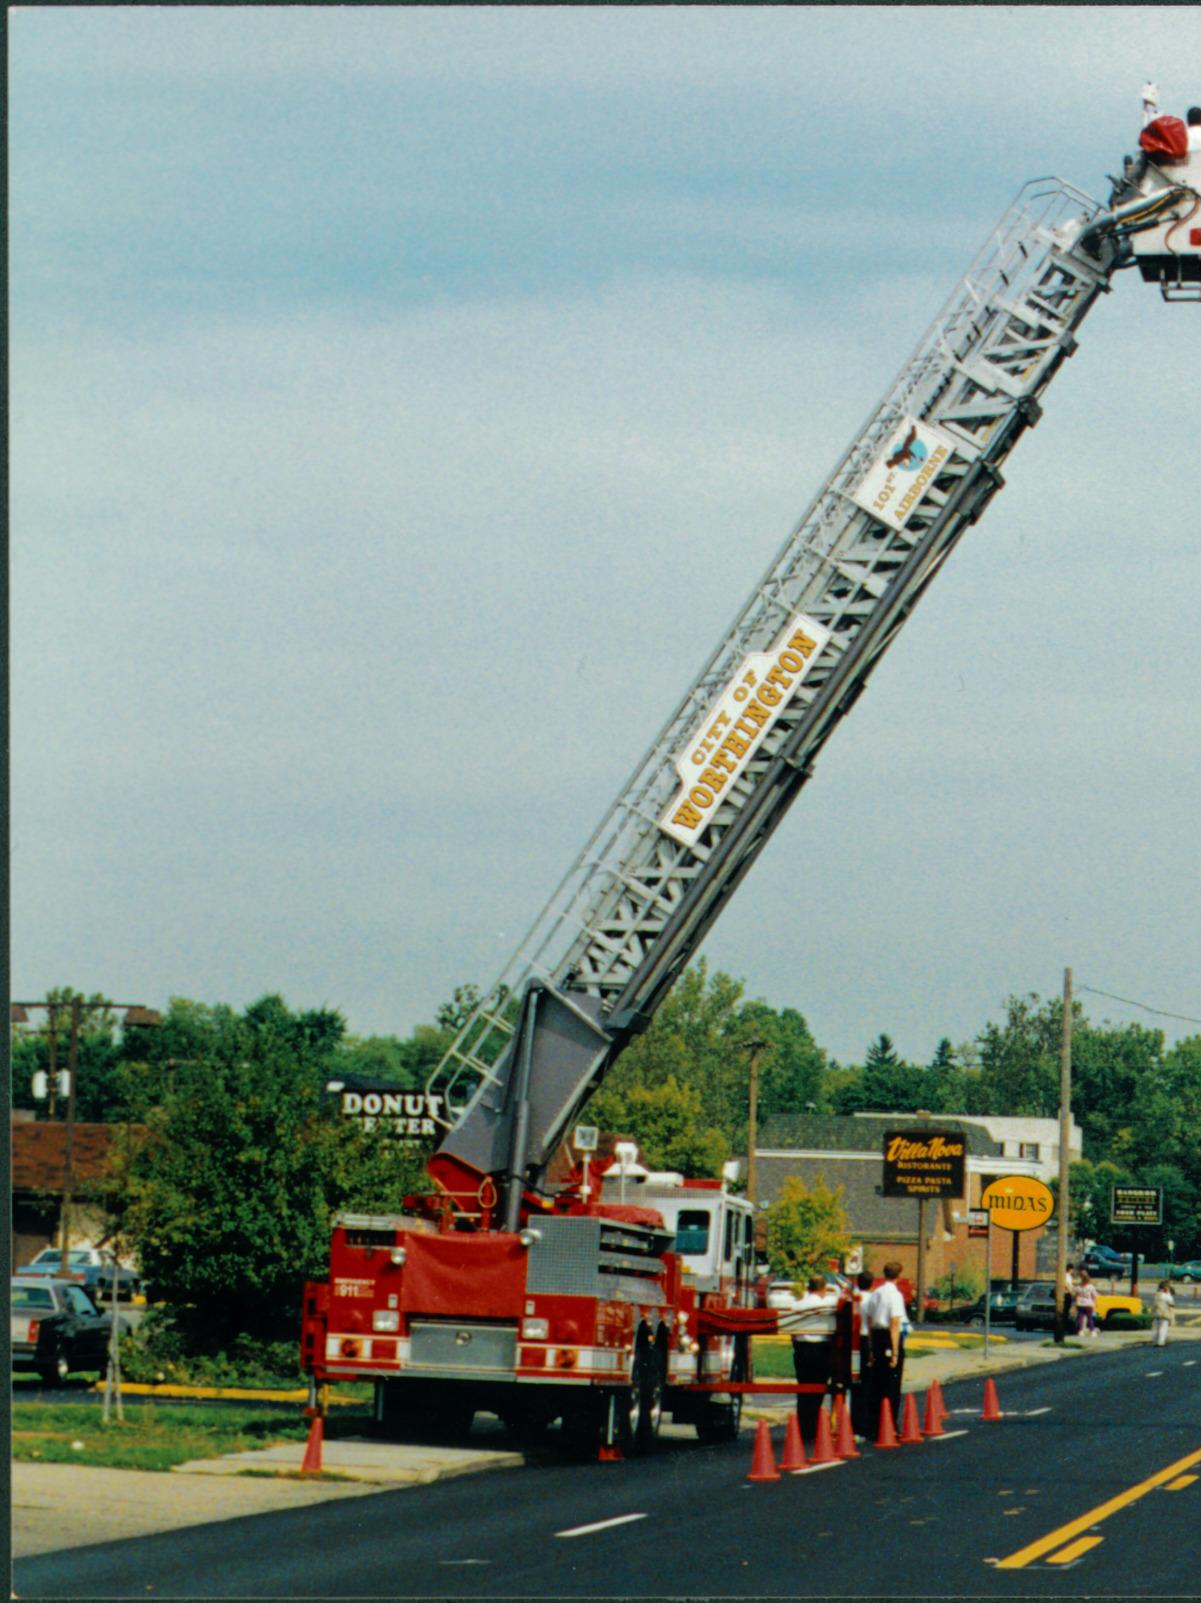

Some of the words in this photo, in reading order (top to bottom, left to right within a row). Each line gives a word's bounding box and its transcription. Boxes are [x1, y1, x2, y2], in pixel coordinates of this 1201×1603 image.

[894, 446, 949, 520] AIRBORNE
[671, 627, 818, 831] WORTHINGTON
[690, 709, 732, 766] CITY
[732, 668, 758, 703] OF
[341, 1092, 444, 1117] DONUT
[355, 1116, 436, 1136] ETER
[886, 1136, 928, 1162] Villa
[927, 1136, 963, 1160] Nova
[896, 1175, 922, 1184] PIZZA
[924, 1176, 952, 1185] PASTA
[988, 1194, 1048, 1213] MIDAS
